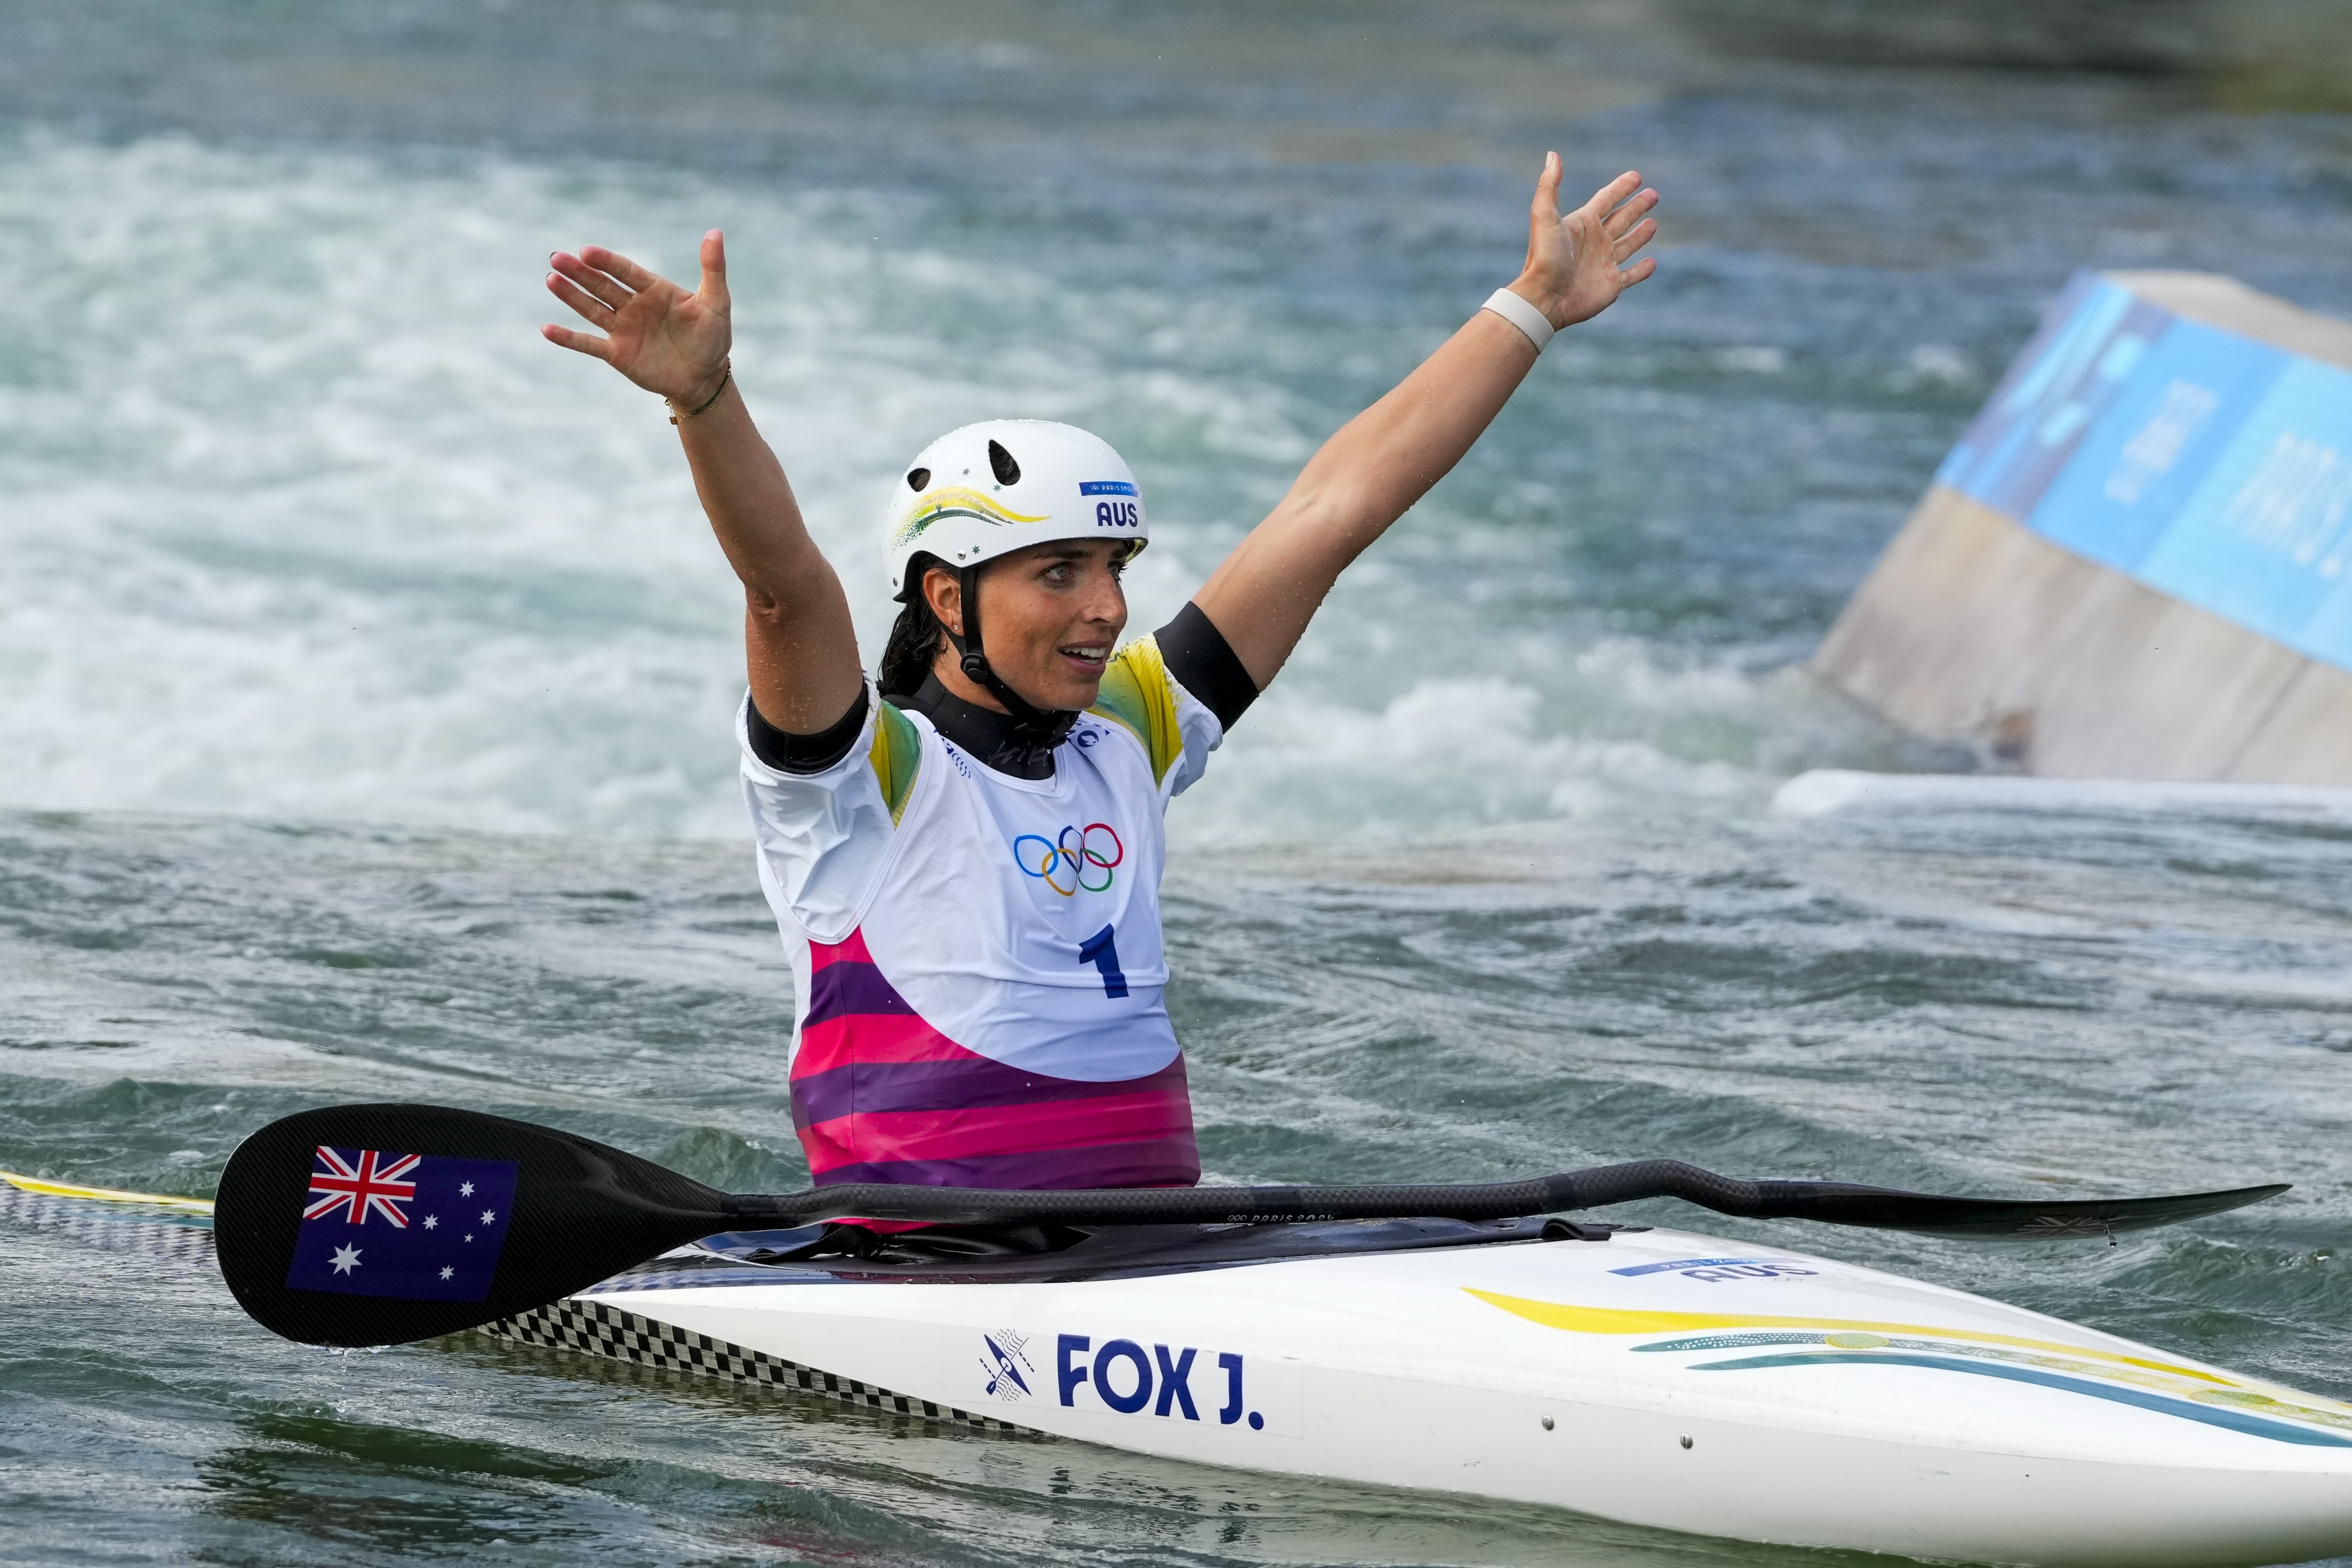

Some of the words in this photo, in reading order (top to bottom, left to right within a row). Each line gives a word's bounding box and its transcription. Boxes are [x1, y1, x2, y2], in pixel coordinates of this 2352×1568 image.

[1096, 502, 1138, 527] AUS
[1078, 922, 1129, 999] 1
[1251, 1214, 1292, 1222] PARIS
[1660, 1260, 1711, 1268] PARIS
[1680, 1264, 1819, 1283] AUS
[1057, 1333, 1201, 1422] FOX
[1218, 1351, 1265, 1431] J.
